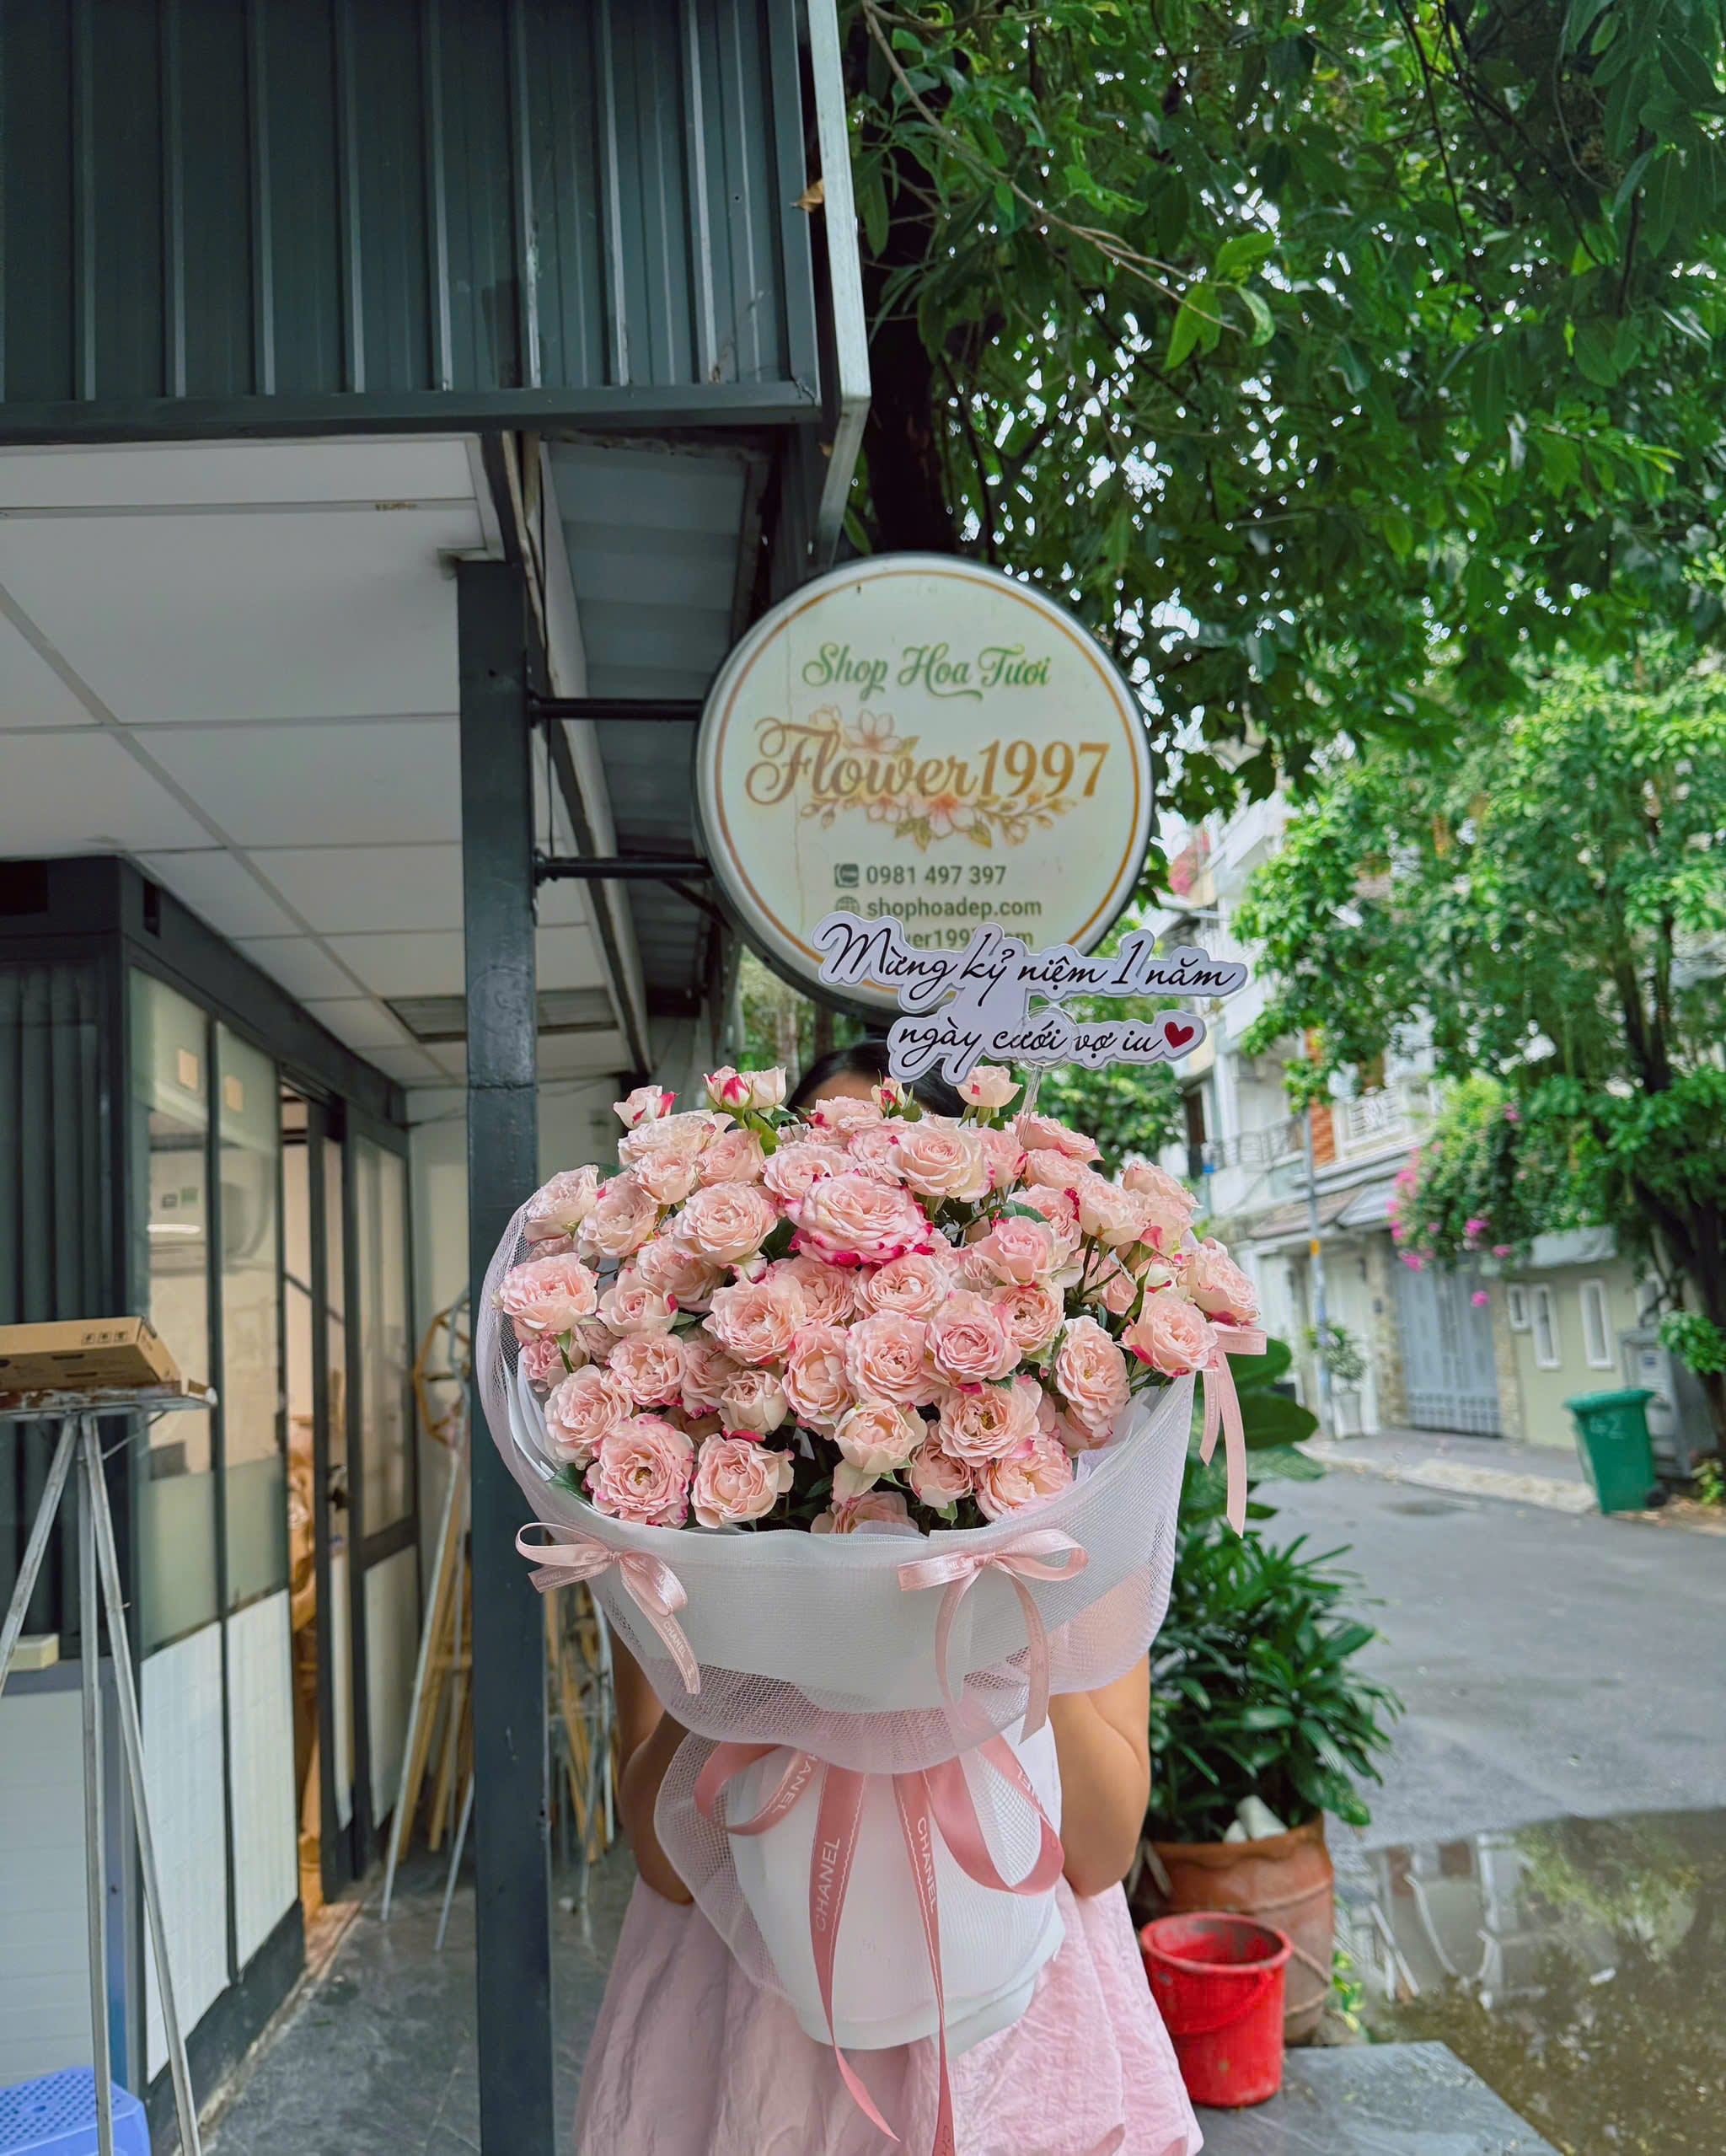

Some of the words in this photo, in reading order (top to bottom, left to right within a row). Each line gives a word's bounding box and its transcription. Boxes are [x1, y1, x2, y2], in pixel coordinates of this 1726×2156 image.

[802, 642, 889, 701] Shop
[898, 642, 983, 701] Hoa
[866, 866, 916, 884] 0981
[925, 866, 962, 884] 497
[969, 866, 1007, 884] 397
[867, 897, 1043, 920] shophoadep.com
[821, 923, 958, 1000] Mừng
[960, 932, 1015, 1007] kỷ
[1016, 956, 1108, 990] niệm
[1111, 940, 1144, 984] 1
[1144, 957, 1236, 985] năm
[898, 1016, 981, 1074] ngày
[993, 1020, 1068, 1050] cưới
[1073, 1032, 1118, 1059] vợ
[1122, 1030, 1162, 1052] iu
[663, 1622, 687, 1659] CHANEL
[771, 1753, 819, 1814] HANEL
[815, 1837, 841, 1932] CHANEL
[917, 1816, 938, 1914] CHANEL
